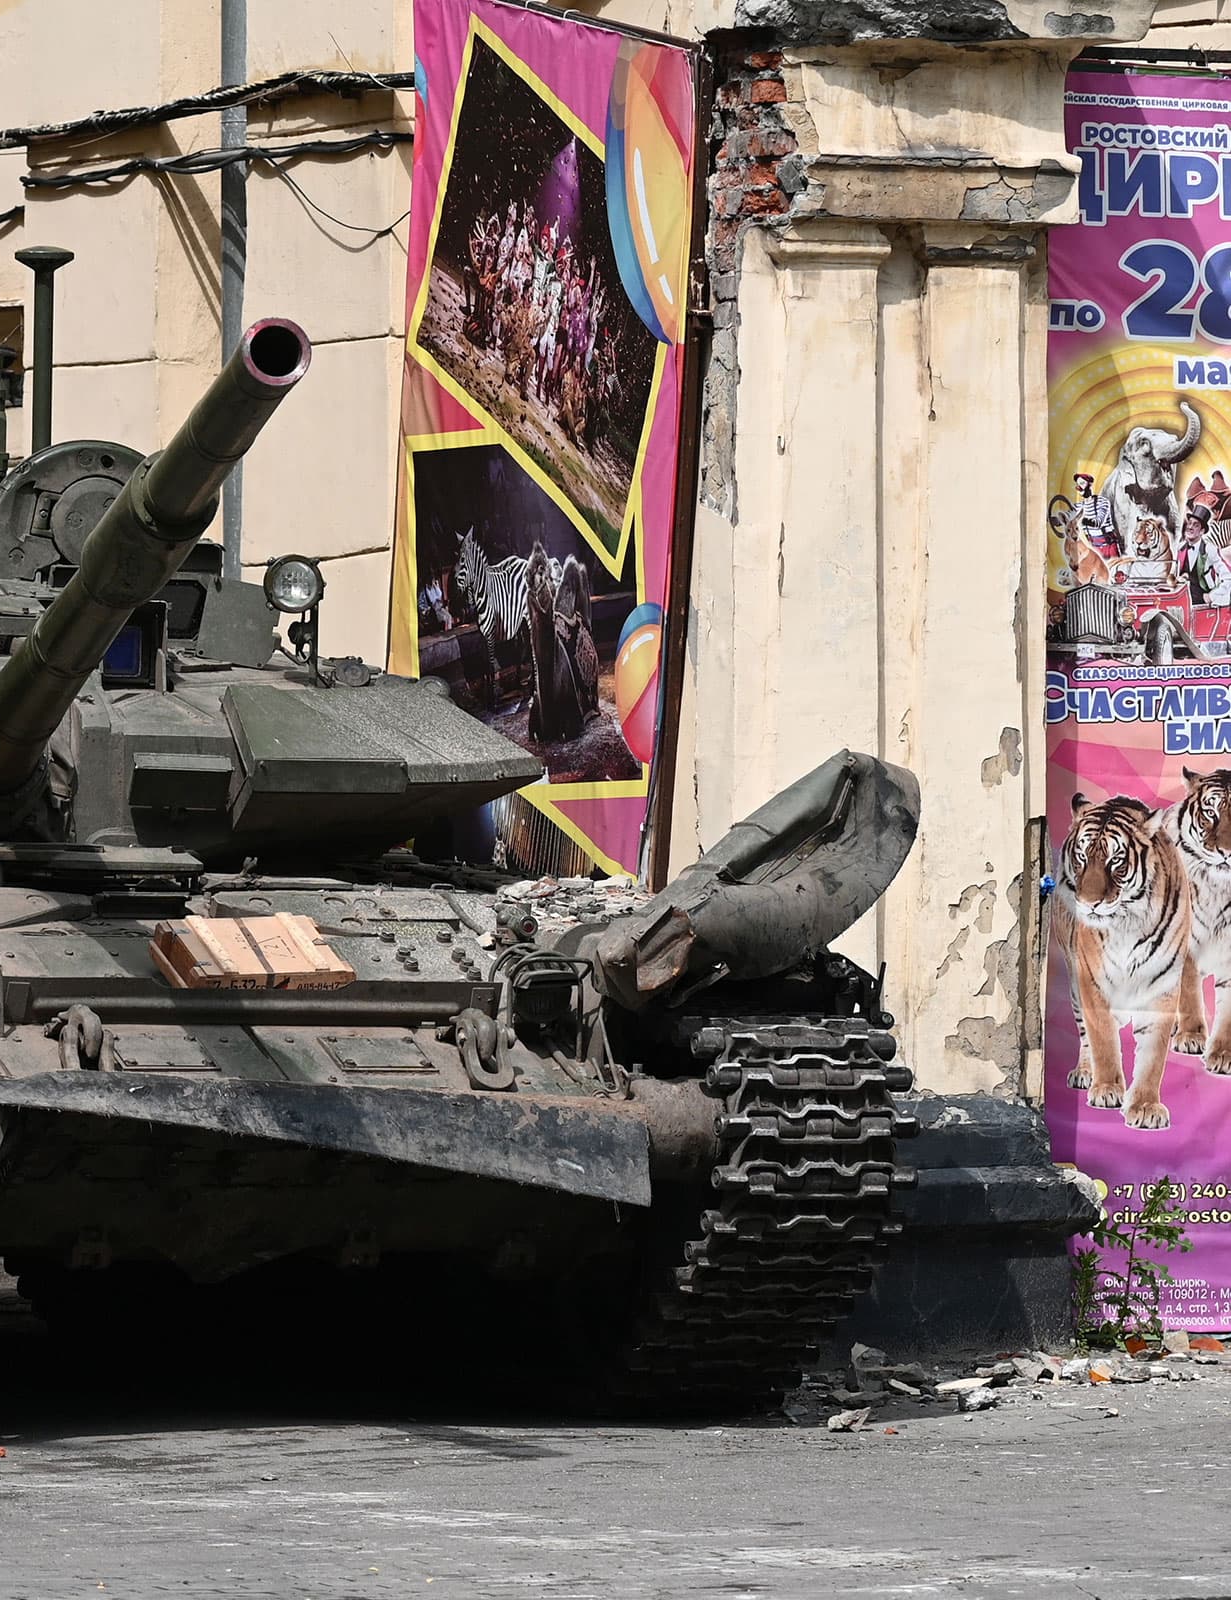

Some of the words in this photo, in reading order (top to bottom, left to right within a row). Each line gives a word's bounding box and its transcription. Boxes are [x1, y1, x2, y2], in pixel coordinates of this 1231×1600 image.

[1099, 96, 1179, 108] ГОСУДАРСТВЕННАЯ
[1182, 100, 1228, 110] ЦИРКОВАЯ
[1084, 126, 1229, 149] РОСТОВСКИЙ
[1049, 303, 1102, 327] по
[1177, 359, 1231, 387] ма
[1073, 667, 1157, 681] СКАЗОЧНОЕ
[1158, 664, 1229, 680] ЦИРКОВОЕ
[1113, 1184, 1134, 1199] +7
[1140, 1183, 1186, 1203] (83)
[1168, 1289, 1207, 1299] 109012
[1188, 1303, 1211, 1316] стр.
